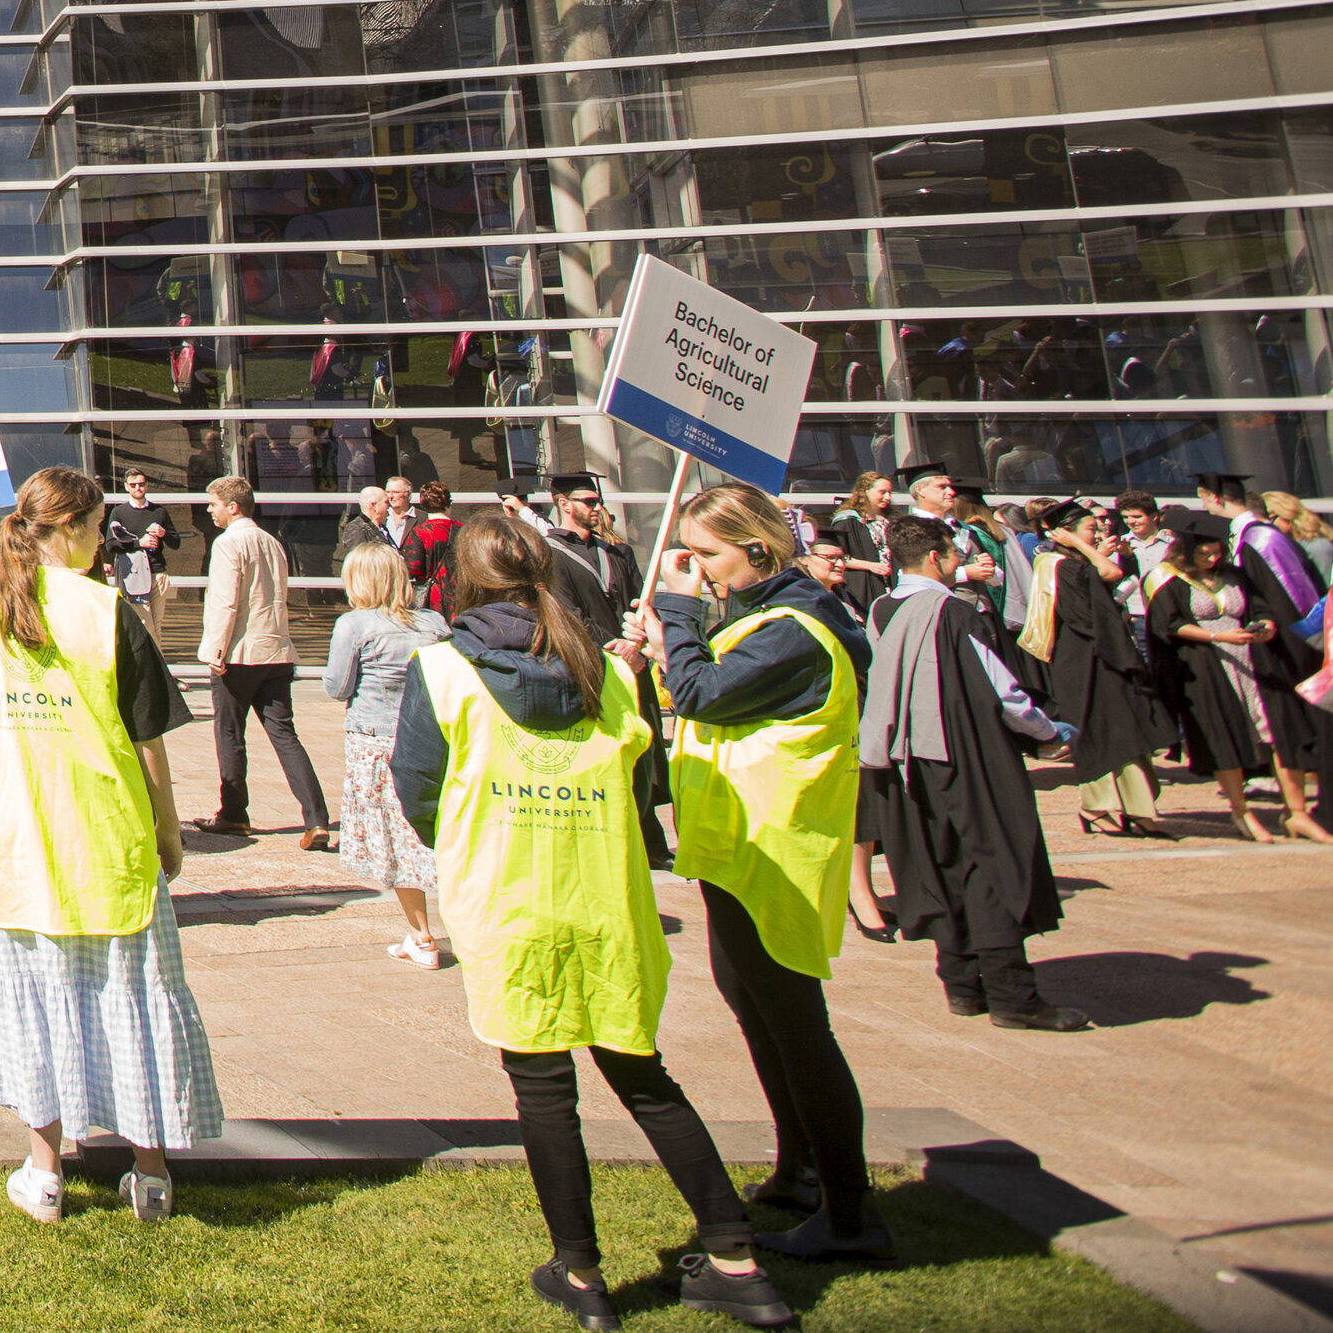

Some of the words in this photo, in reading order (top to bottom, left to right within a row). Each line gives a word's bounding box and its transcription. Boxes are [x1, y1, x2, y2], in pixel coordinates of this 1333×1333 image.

[674, 300, 752, 355] Bachelor
[754, 347, 776, 366] of
[665, 327, 769, 394] Agricultural
[674, 361, 746, 412] Science
[684, 430, 728, 456] UNIVERSITY
[685, 423, 717, 443] LINCOLN
[6, 711, 63, 721] NIVERSITY
[491, 781, 606, 802] LINCOLN
[509, 805, 592, 818] UNIVERSITY
